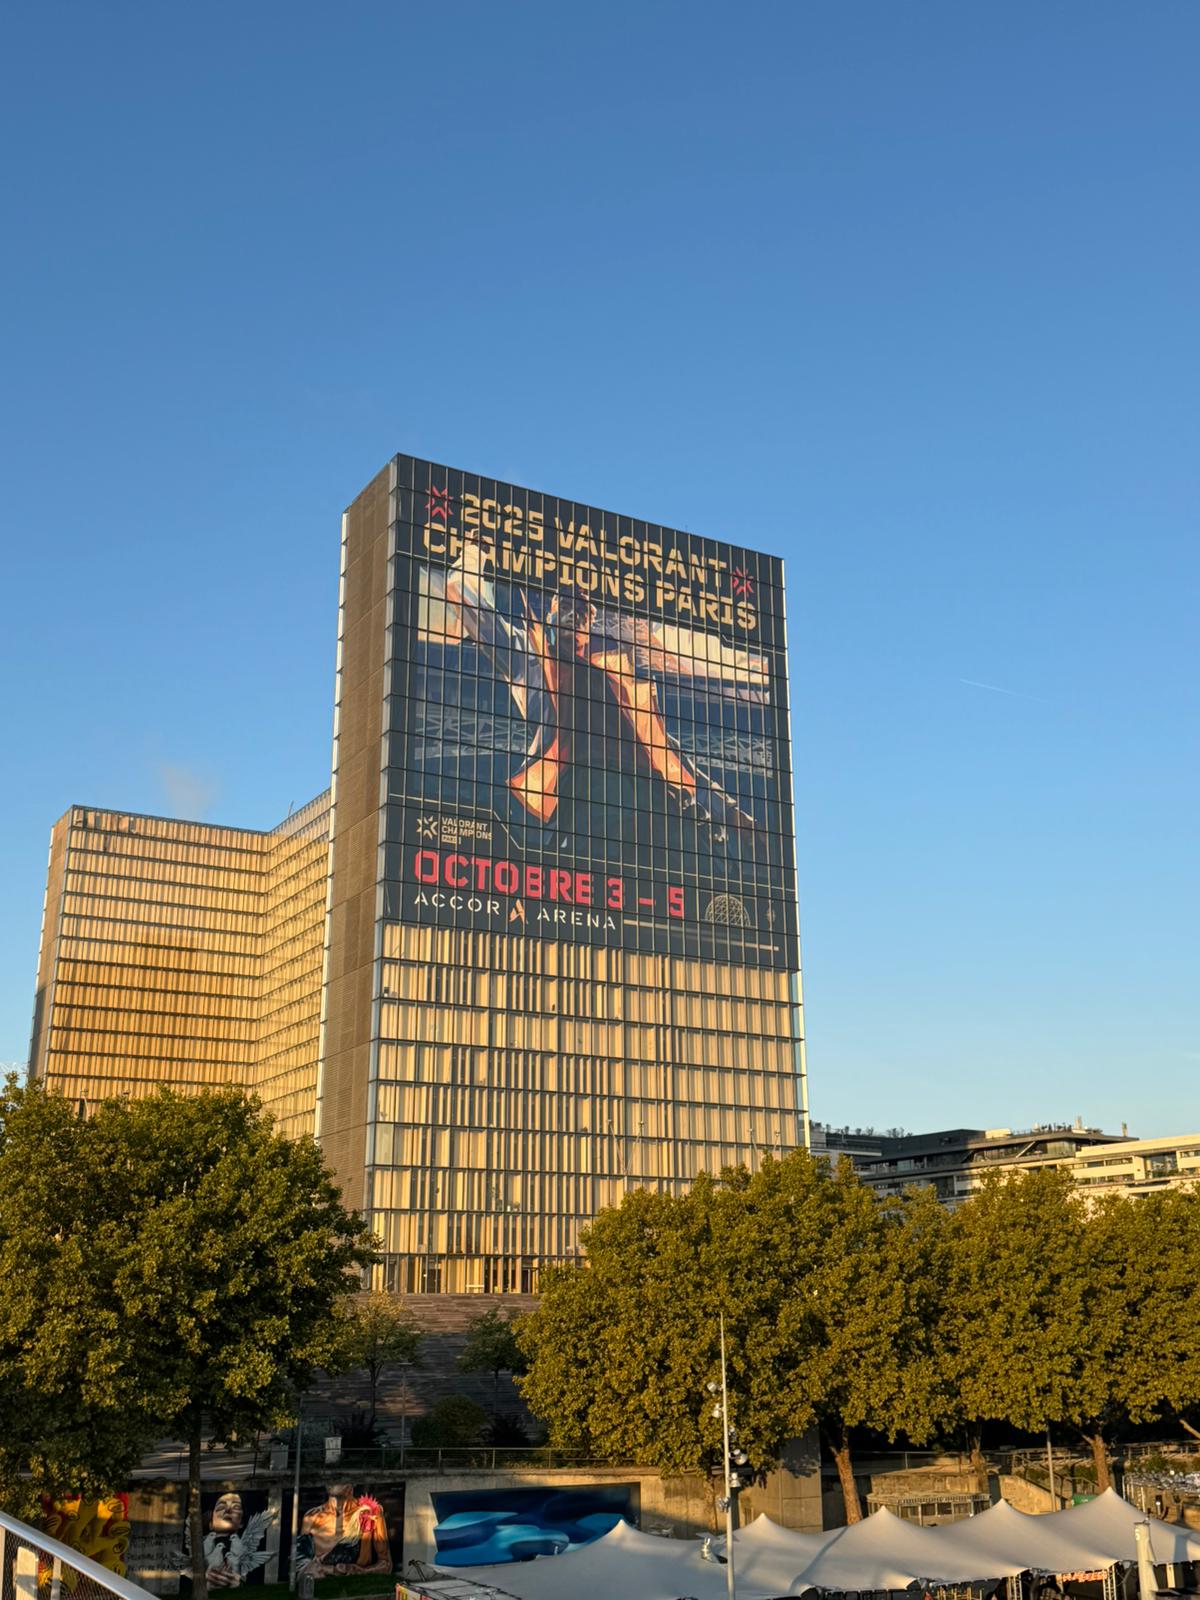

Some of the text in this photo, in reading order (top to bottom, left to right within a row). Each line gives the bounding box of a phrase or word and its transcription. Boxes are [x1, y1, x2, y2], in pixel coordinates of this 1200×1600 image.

[460, 492, 728, 588] 2025 VALORANT
[423, 522, 757, 630] CHAMPIONS PARIS
[442, 816, 488, 831] VALORANT
[442, 825, 492, 840] CHAMPONS
[414, 850, 593, 905] OCTOBRE
[607, 877, 625, 909] 3
[668, 886, 685, 917] 5
[414, 891, 501, 915] ACCOR
[537, 907, 616, 930] ARENA
